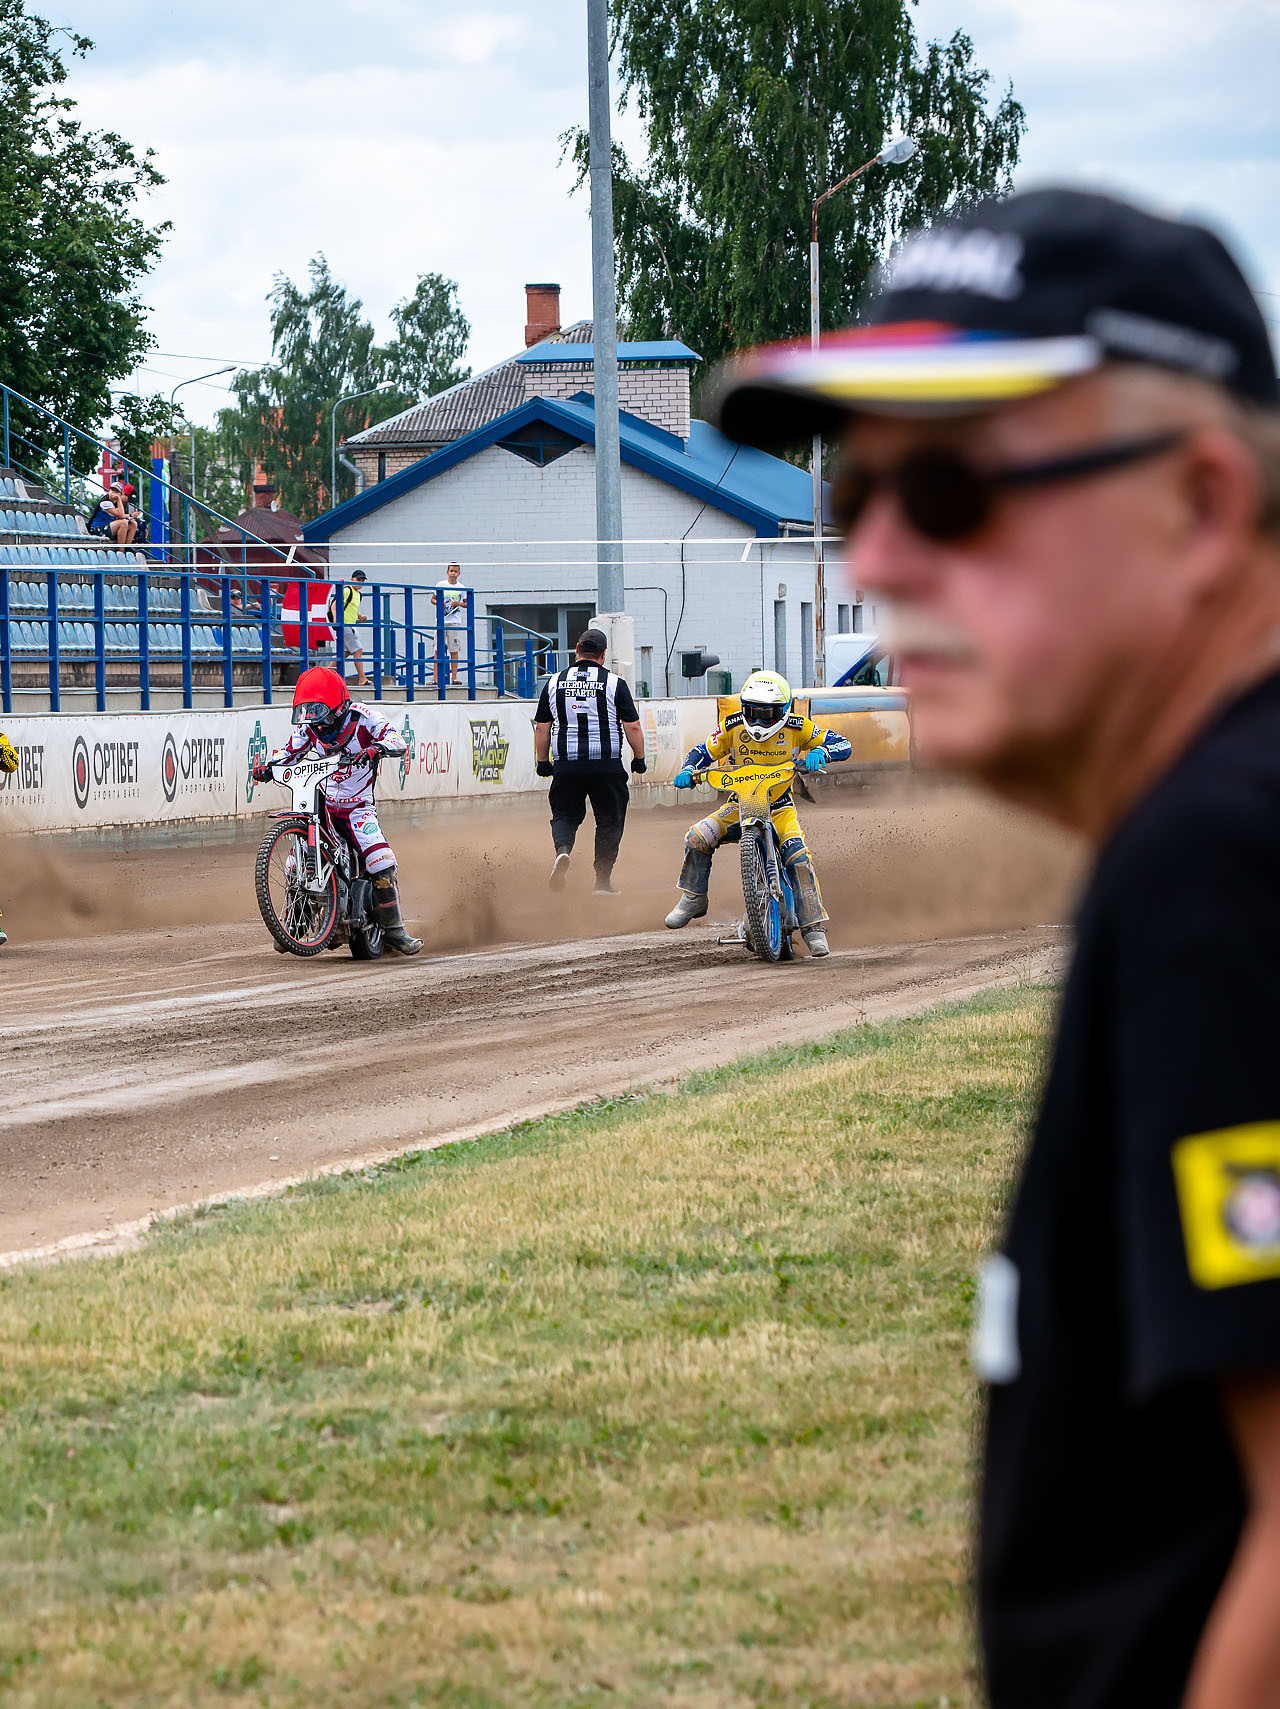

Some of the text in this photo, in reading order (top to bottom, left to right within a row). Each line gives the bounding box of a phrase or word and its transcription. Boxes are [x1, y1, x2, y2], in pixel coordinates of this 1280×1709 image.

[558, 680, 605, 691] KIEROWNIK
[564, 689, 597, 698] STARTU
[180, 738, 225, 780] OPTIBET
[749, 748, 787, 757] spechouse
[93, 742, 139, 786] OPTIBET
[293, 761, 330, 776] OPTIBET
[734, 771, 782, 784] spechouse
